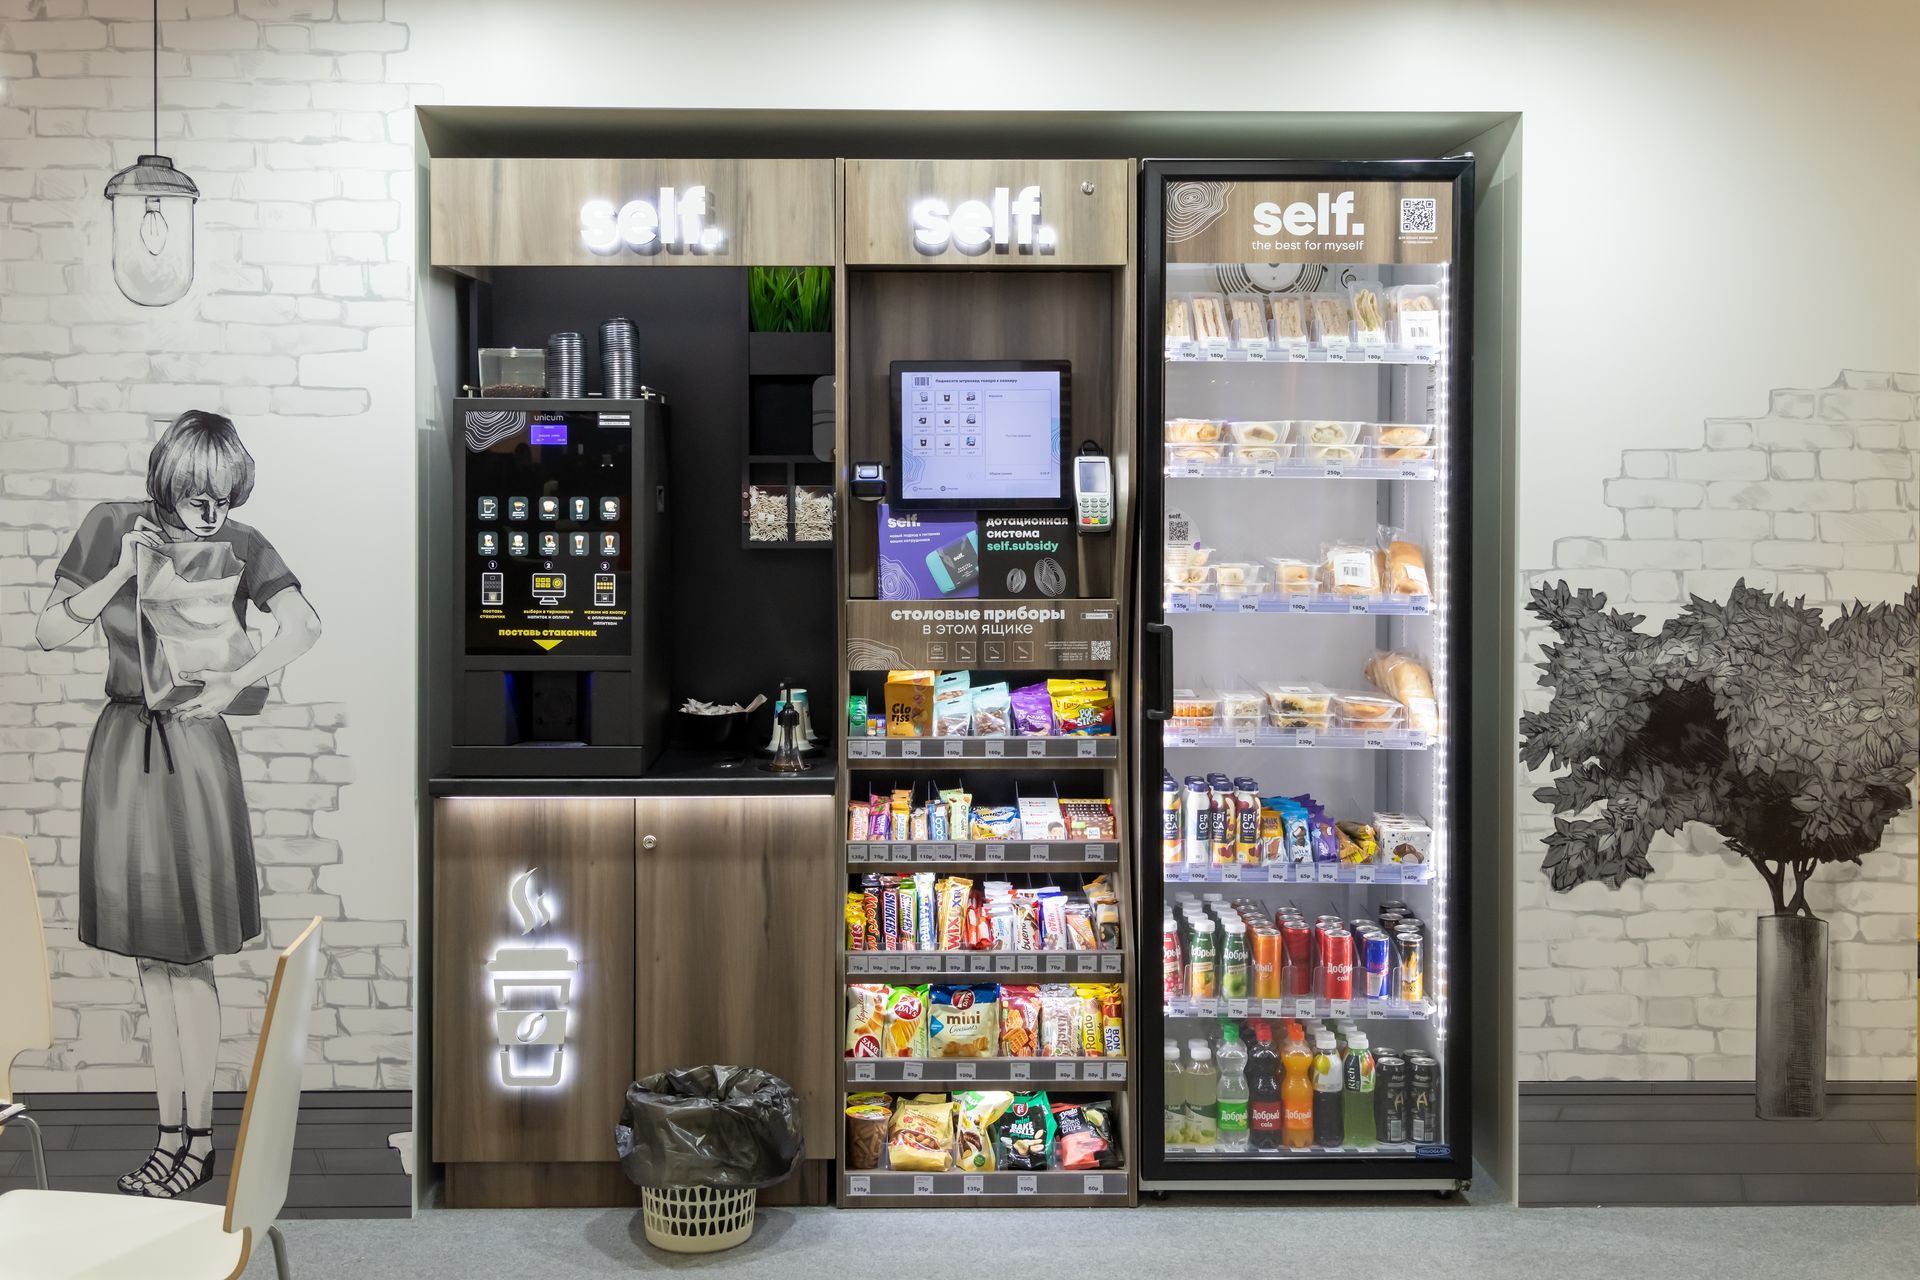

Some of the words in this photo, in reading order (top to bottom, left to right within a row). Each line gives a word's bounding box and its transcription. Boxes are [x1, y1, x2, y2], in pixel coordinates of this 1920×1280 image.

[580, 186, 720, 247] self.
[912, 186, 1057, 247] self.
[1252, 191, 1365, 236] self.
[1252, 240, 1271, 250] the
[1274, 240, 1301, 250] best
[1304, 240, 1322, 250] for
[1324, 240, 1364, 252] myself
[534, 414, 564, 422] unicum
[887, 513, 921, 528] self.
[986, 517, 1069, 528] дотационная
[986, 529, 1040, 539] система
[986, 540, 1059, 553] self.subsidy
[891, 608, 981, 621] столовые
[983, 606, 1066, 624] приборы
[498, 628, 541, 637] поставь
[542, 629, 598, 637] стаканчик
[922, 625, 931, 634] в
[936, 624, 978, 635] этом
[981, 623, 1034, 637] ящике
[892, 703, 912, 714] Glo
[865, 892, 879, 936] Mars
[886, 893, 897, 936] SNICKERS
[894, 1004, 918, 1018] DAYS
[946, 1010, 980, 1024] mini
[1085, 1014, 1095, 1050] Rondo
[1112, 1028, 1120, 1050] BON
[1348, 1067, 1356, 1089] Rich
[1014, 1116, 1030, 1124] mini
[1252, 1109, 1280, 1120] Добрый
[1009, 1128, 1035, 1136] ROLLS
[1011, 1122, 1033, 1130] BAKE
